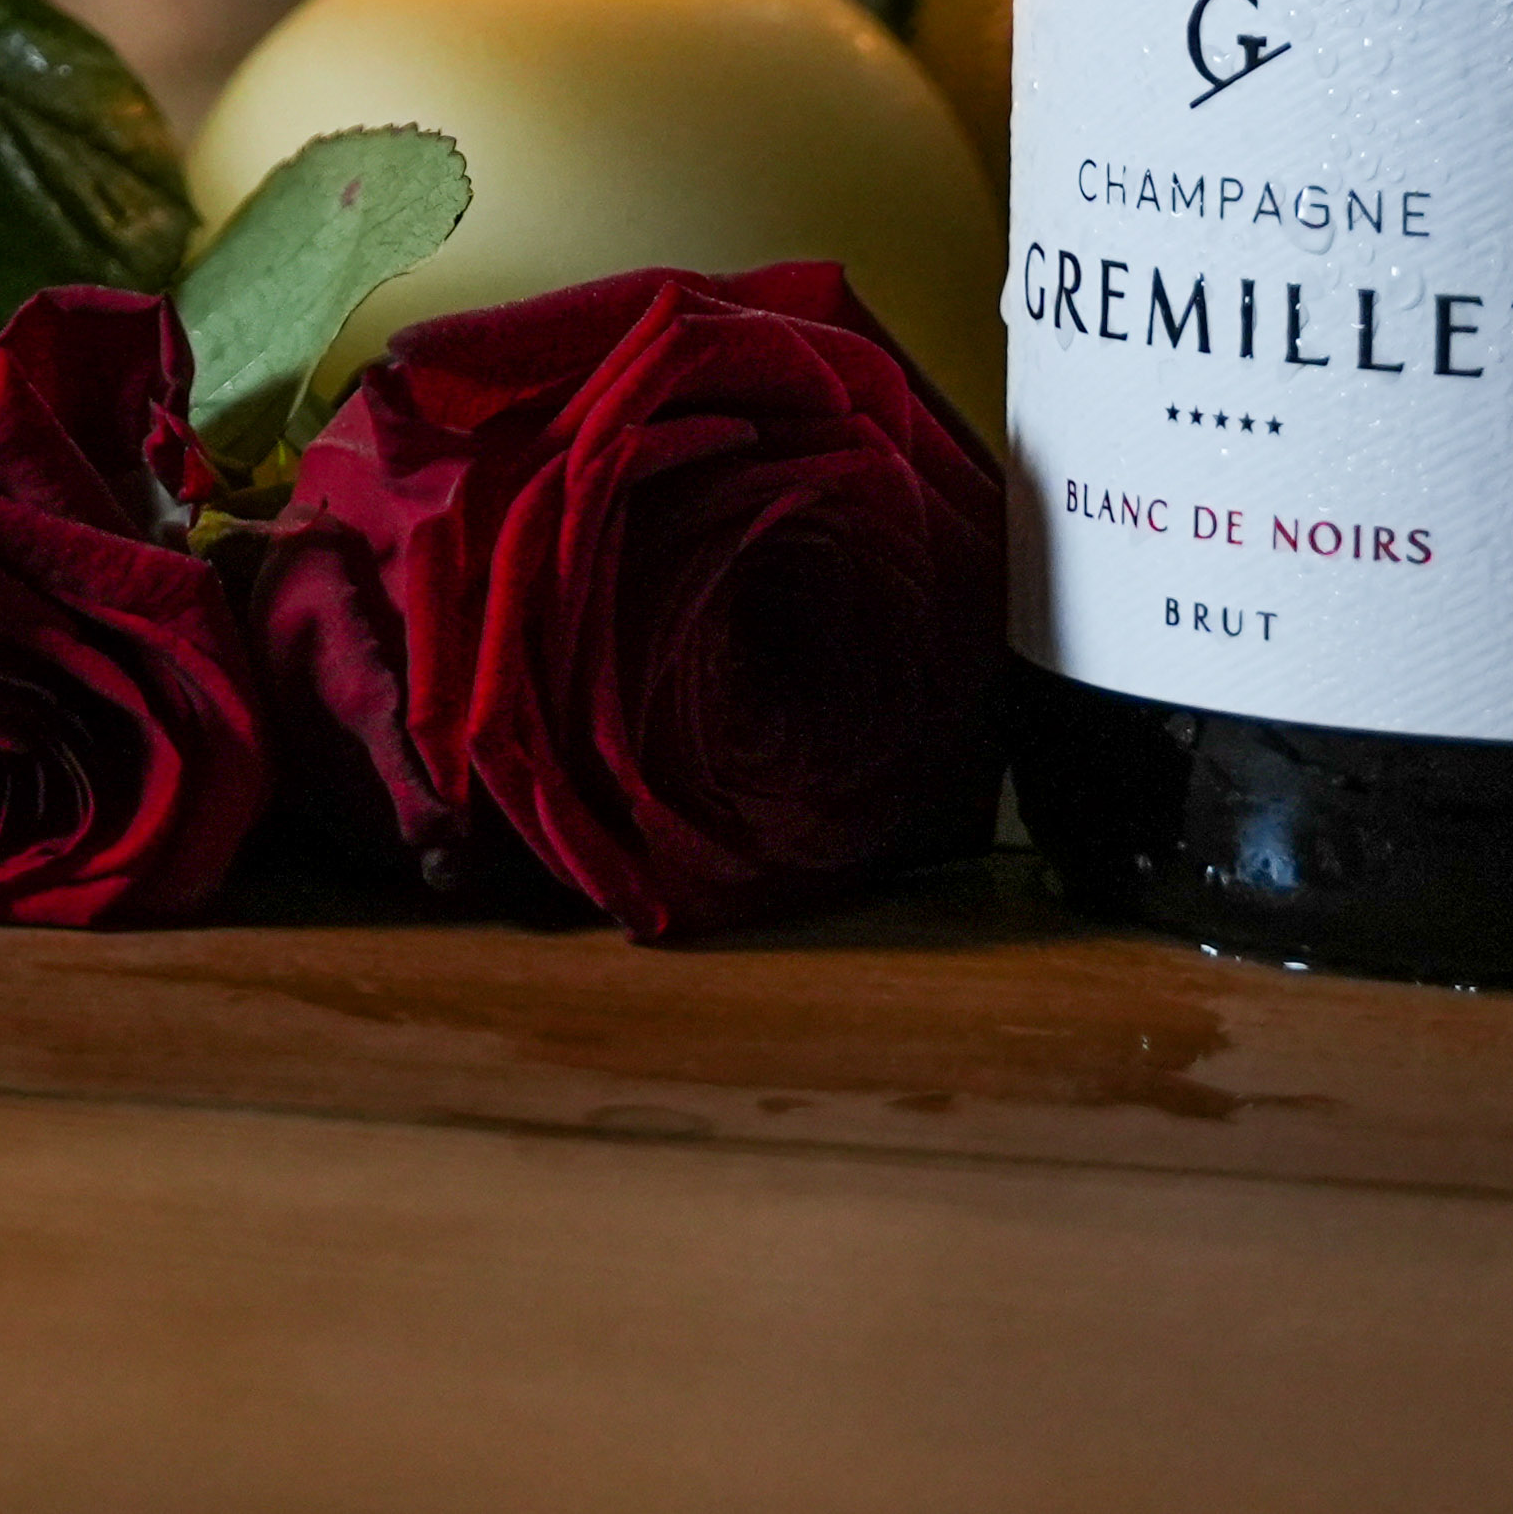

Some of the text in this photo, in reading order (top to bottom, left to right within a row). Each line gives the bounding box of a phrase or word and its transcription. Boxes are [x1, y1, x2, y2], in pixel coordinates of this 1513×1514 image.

[1077, 157, 1433, 239] CHAMPAGNE
[1064, 477, 1434, 566] BLANC DE NOIRS
[1164, 595, 1279, 643] BRUT
